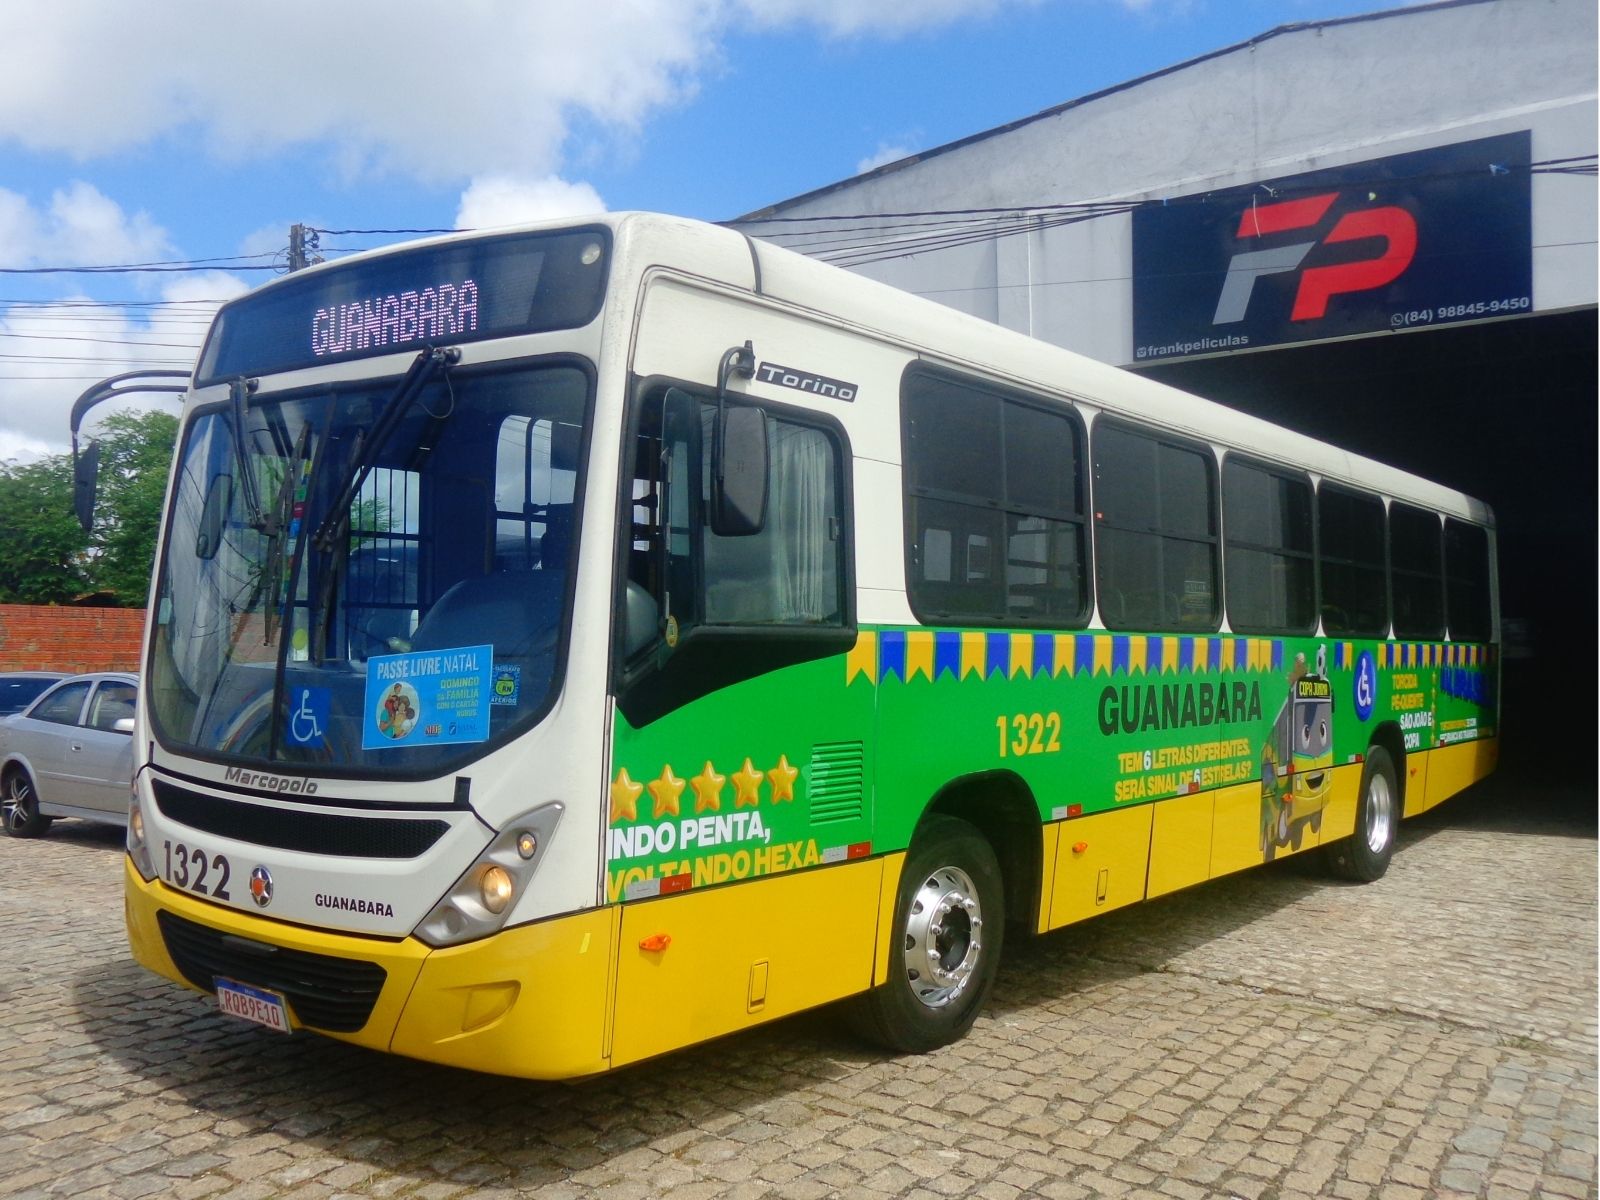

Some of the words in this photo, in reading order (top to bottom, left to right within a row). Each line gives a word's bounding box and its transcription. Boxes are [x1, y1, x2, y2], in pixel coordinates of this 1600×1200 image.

[311, 279, 477, 356] GUANABARA
[1404, 308, 1434, 326] (84)
[1437, 296, 1530, 319] 98845-9450
[1147, 333, 1249, 358] frankpeliculas
[762, 365, 854, 400] Torino
[377, 659, 409, 680] PASSE
[410, 656, 442, 677] LIVRE
[443, 652, 480, 674] NATAL
[440, 676, 479, 689] DOMINGO
[1097, 681, 1263, 737] GUANABARA
[995, 712, 1061, 758] 1322
[1404, 732, 1420, 749] COPA
[1118, 752, 1143, 774] TEM
[1143, 750, 1152, 771] 6
[1152, 745, 1194, 770] LETRAS
[224, 766, 318, 795] Marcopolo
[1147, 773, 1178, 797] SINAL
[1193, 769, 1201, 786] 6
[1202, 760, 1252, 785] ESTRELAS?
[680, 811, 771, 850] PENTA,
[164, 840, 231, 901] 1322
[315, 893, 394, 918] GUANABARA
